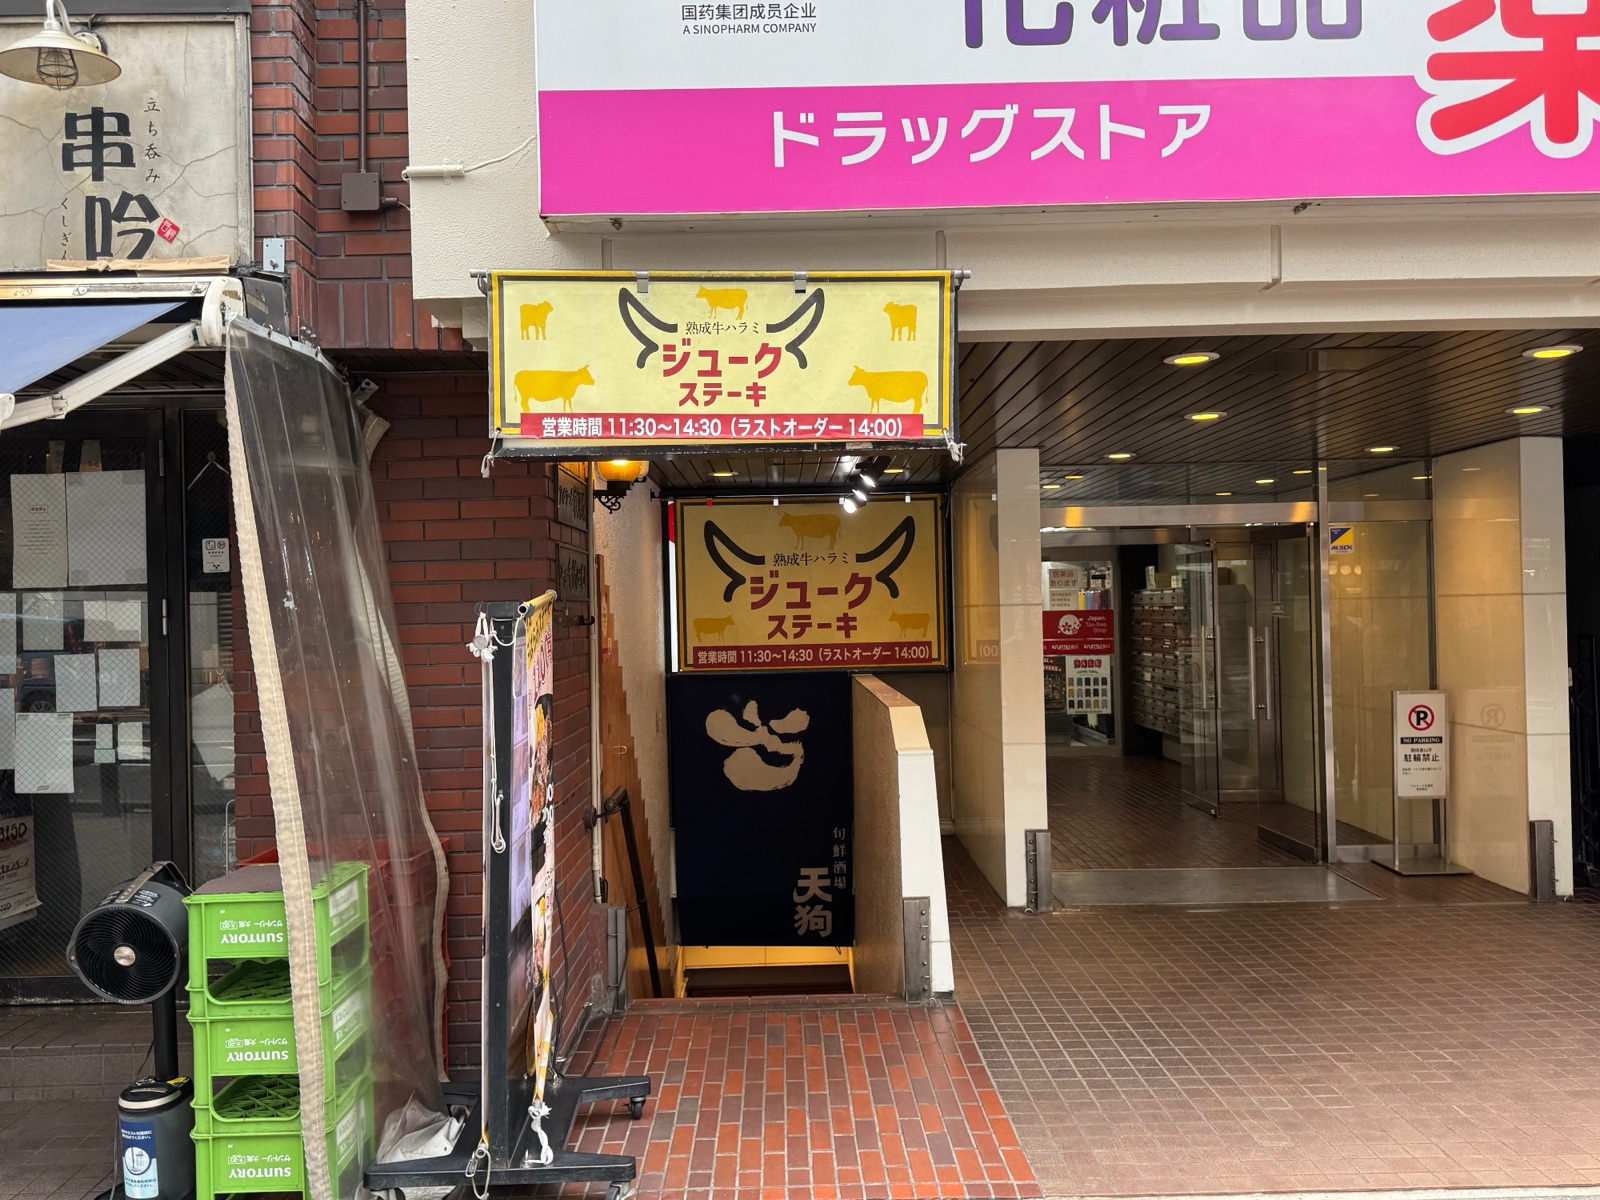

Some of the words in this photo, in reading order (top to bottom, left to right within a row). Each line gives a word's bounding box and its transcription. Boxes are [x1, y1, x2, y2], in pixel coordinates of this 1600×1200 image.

[681, 3, 817, 20] 国药集团成员企业
[683, 25, 690, 34] A
[693, 24, 760, 34] SINOPHARM
[763, 23, 817, 33] COMPANY
[144, 97, 161, 183] 立ち呑み
[774, 104, 1211, 167] ドラッグストア
[62, 107, 160, 261] 串吟
[685, 321, 760, 335] 熟成牛ハラミ
[663, 338, 782, 379] ジューク
[679, 382, 766, 407] ステーキ
[541, 417, 602, 437] 営業時間
[773, 552, 849, 567] 熟成牛ハラミ
[750, 570, 872, 610] ジューク
[768, 612, 857, 640] ステーキ
[697, 651, 737, 664] 営業時間
[1403, 753, 1440, 763] 駐輪禁止
[833, 826, 847, 890] 旬鮮酒場
[793, 867, 833, 938] 天狗
[254, 920, 284, 928] サントリー
[220, 932, 284, 944] SUNTORY
[259, 1038, 289, 1046] サントリー
[226, 1050, 289, 1062] SUNTORY
[262, 1154, 292, 1162] サントリー
[228, 1167, 292, 1179] SUNTORY
